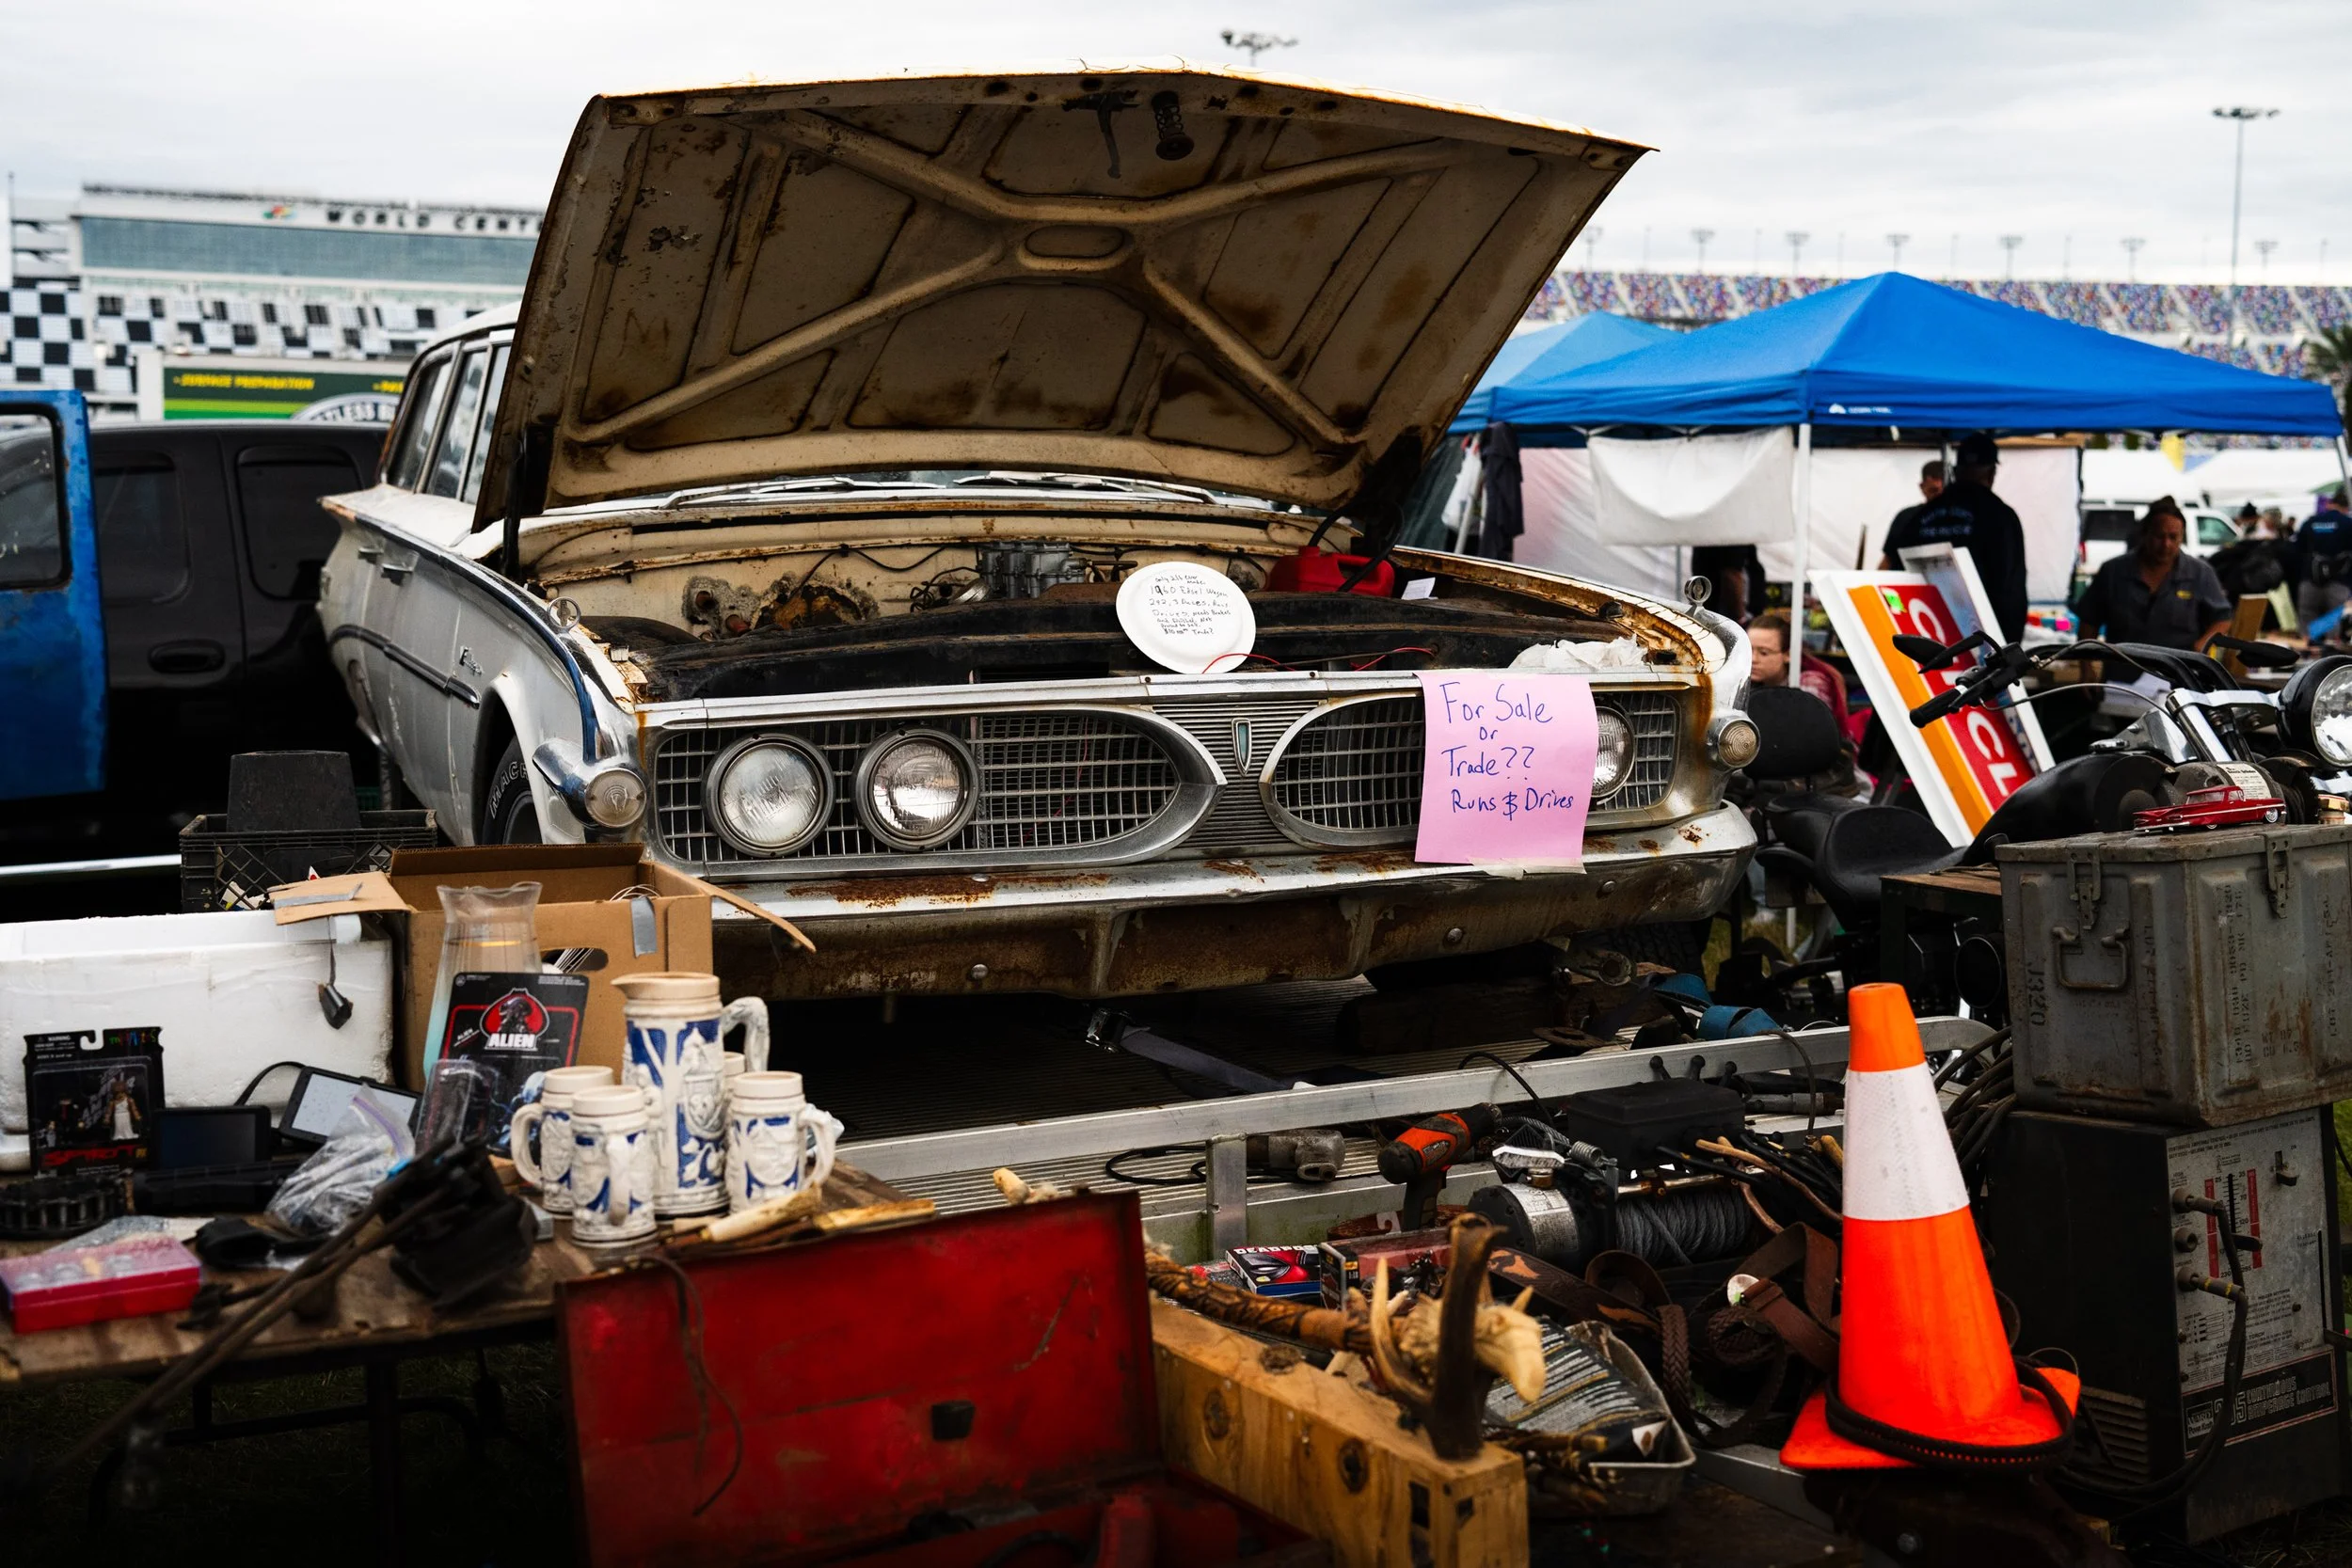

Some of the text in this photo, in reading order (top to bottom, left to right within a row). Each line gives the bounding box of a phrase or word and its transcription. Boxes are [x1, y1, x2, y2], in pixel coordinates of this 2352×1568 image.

[326, 210, 430, 229] WORLD
[1151, 585, 1176, 595] 1960
[1438, 681, 1553, 724] For Sale
[1451, 788, 1497, 814] Runs
[1525, 787, 1574, 812] Drives
[488, 1033, 536, 1048] ALIEN
[1233, 1244, 1318, 1255] DEADPO
